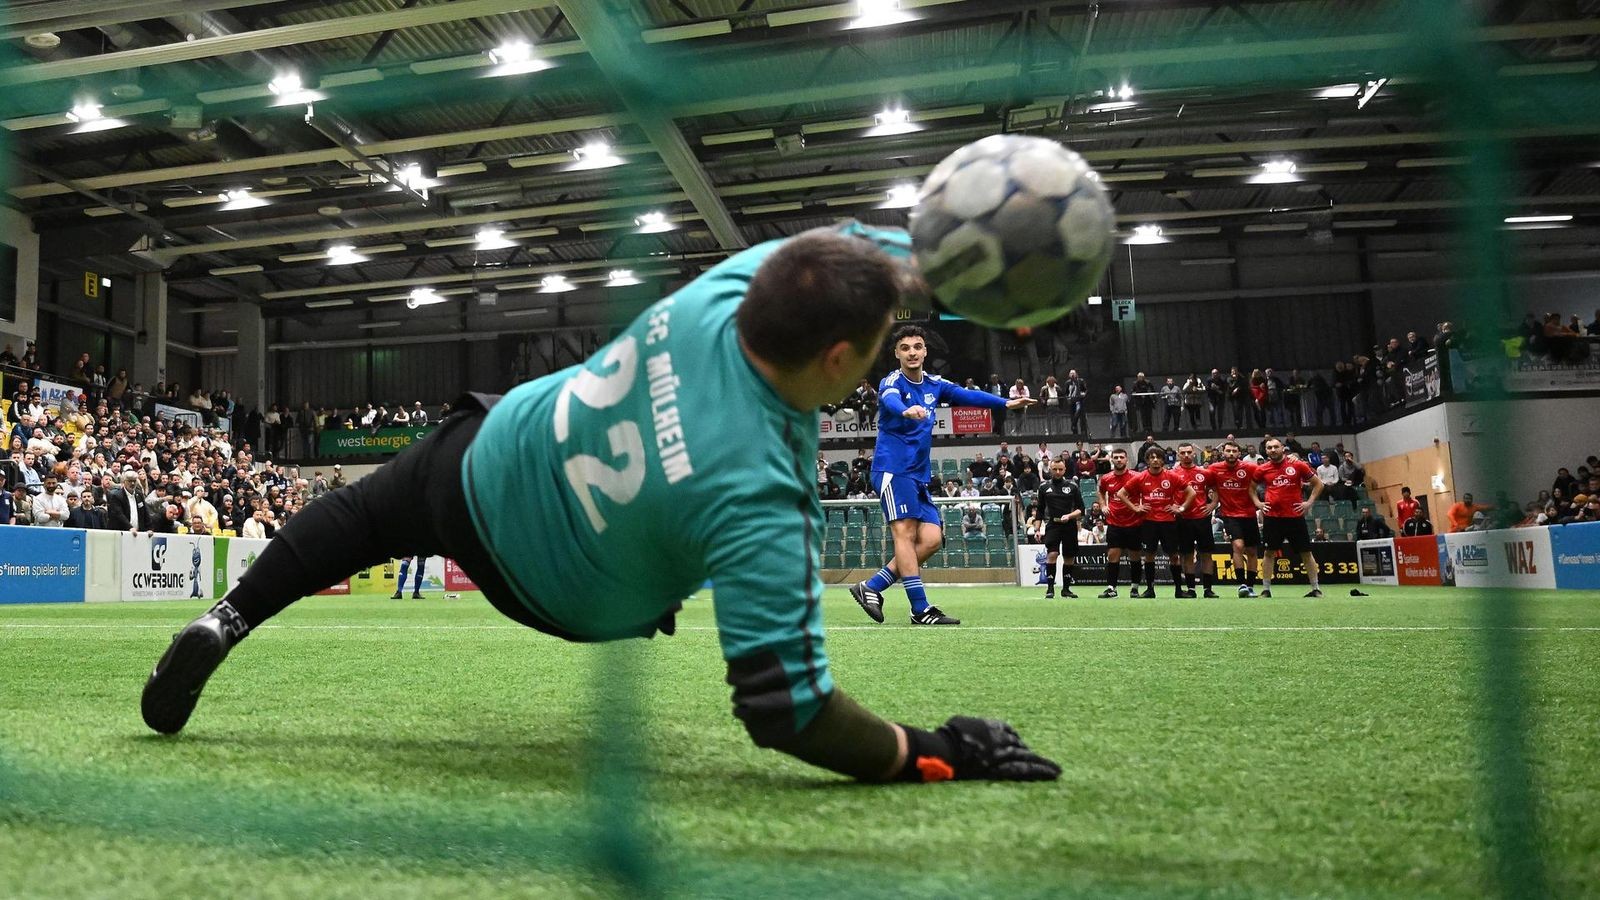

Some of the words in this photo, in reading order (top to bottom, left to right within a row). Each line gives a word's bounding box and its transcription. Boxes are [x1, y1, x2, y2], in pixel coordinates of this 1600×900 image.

[1118, 306, 1130, 320] F
[647, 352, 694, 485] MÜLHEIM
[953, 409, 982, 417] KÖNNER
[337, 434, 411, 449] westenergie
[553, 335, 646, 534] 22
[1504, 540, 1538, 575] WAZ
[31, 563, 59, 579] spielen
[60, 563, 80, 576] fairer!
[1324, 562, 1334, 574] 3
[1338, 562, 1359, 574] 33
[144, 573, 184, 589] WERBUNG
